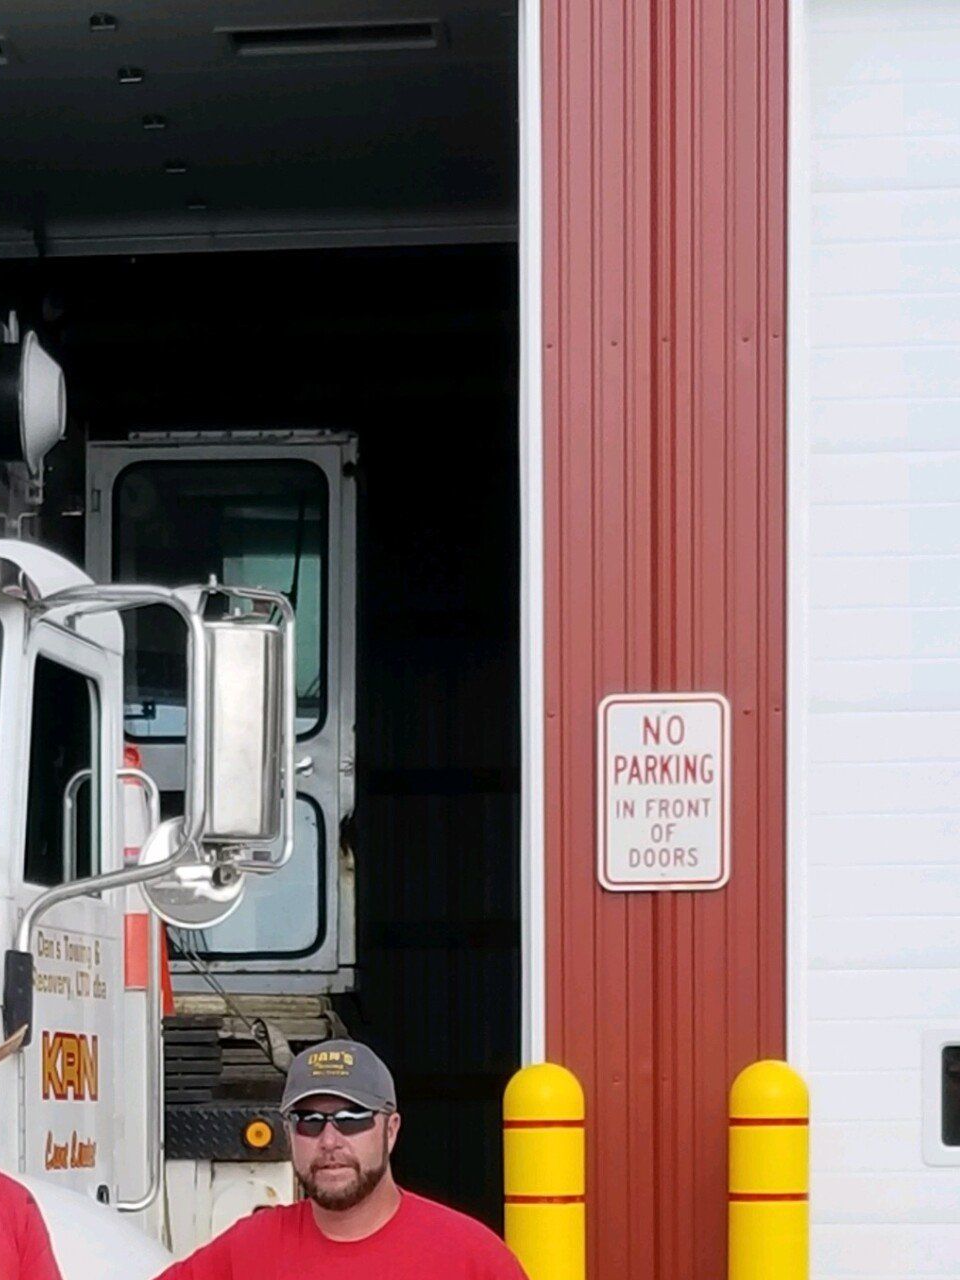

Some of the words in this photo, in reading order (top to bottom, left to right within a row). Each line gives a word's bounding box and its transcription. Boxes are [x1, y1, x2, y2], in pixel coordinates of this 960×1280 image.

[642, 714, 685, 746] NO
[614, 753, 714, 786] PARKING
[616, 799, 635, 819] IN
[646, 797, 711, 818] FRONT
[650, 823, 676, 843] OF
[628, 847, 699, 869] DOORS
[42, 1030, 98, 1101] KRN
